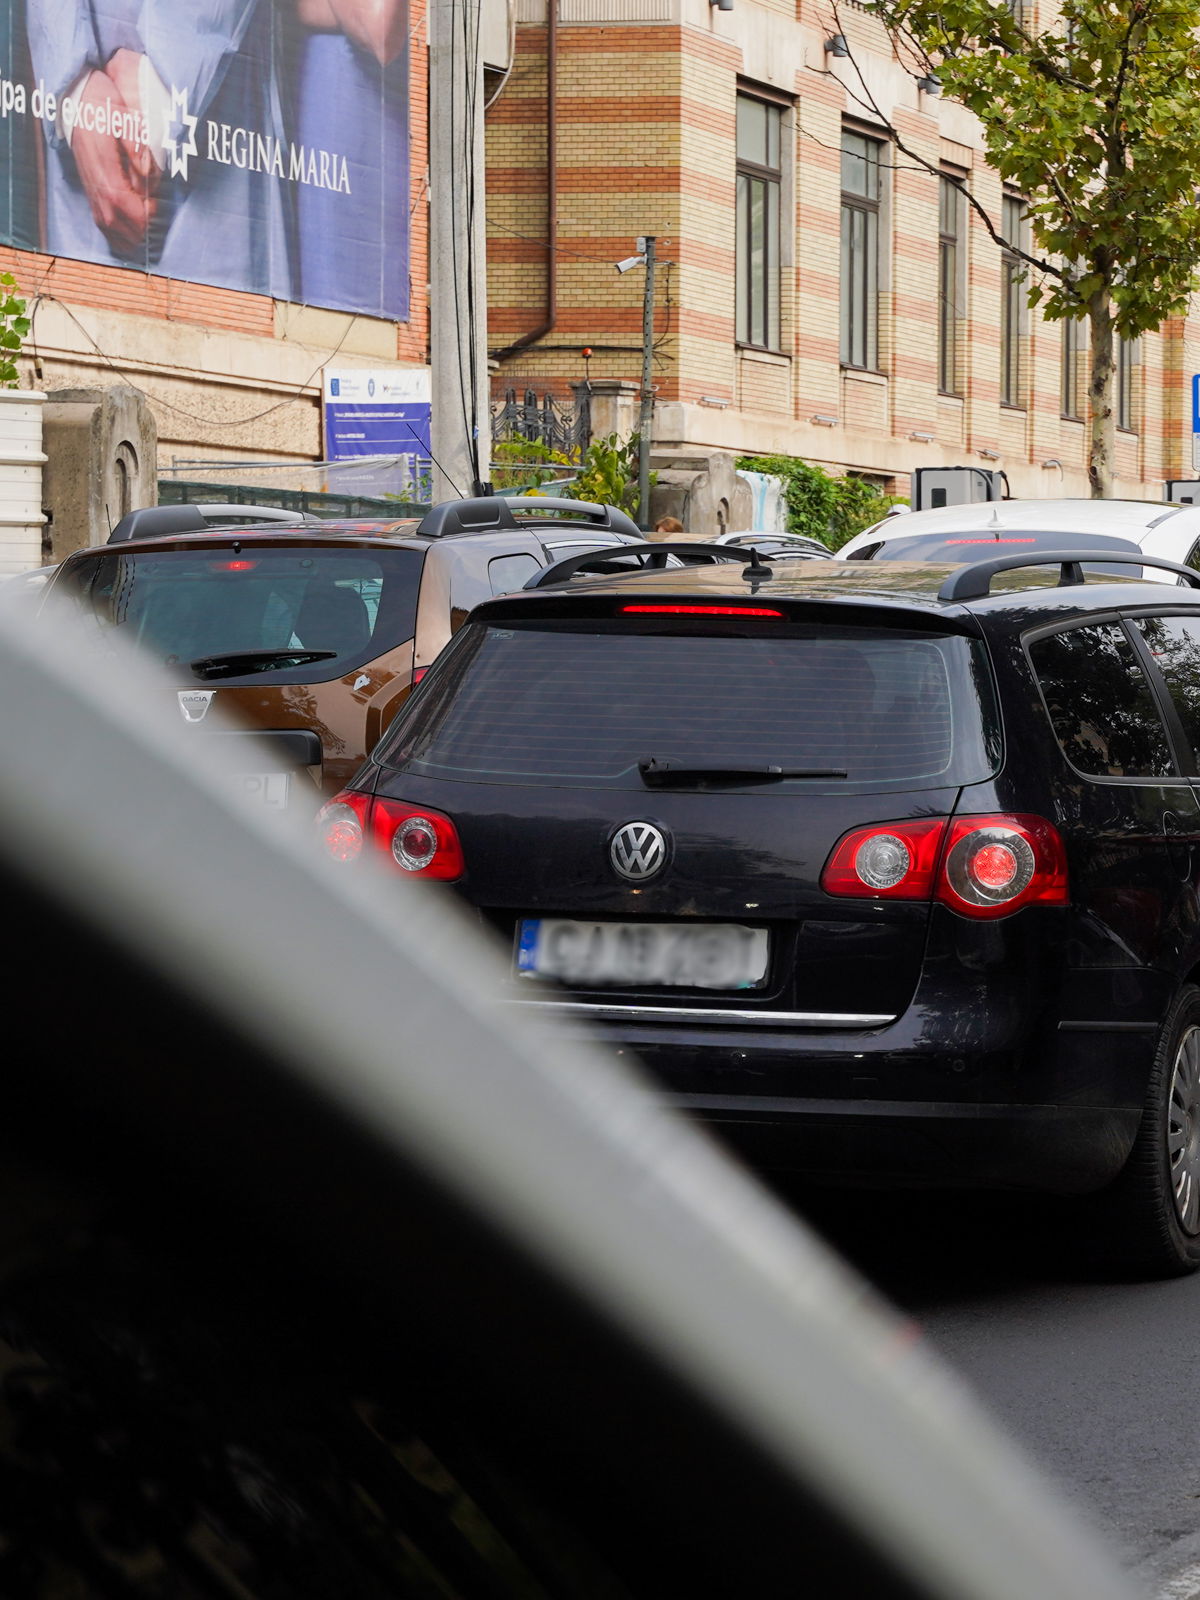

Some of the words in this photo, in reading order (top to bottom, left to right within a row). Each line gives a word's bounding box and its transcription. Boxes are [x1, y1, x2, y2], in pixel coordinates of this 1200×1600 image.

[31, 78, 57, 121] de
[207, 120, 285, 178] REGINA
[289, 142, 351, 194] MARIA
